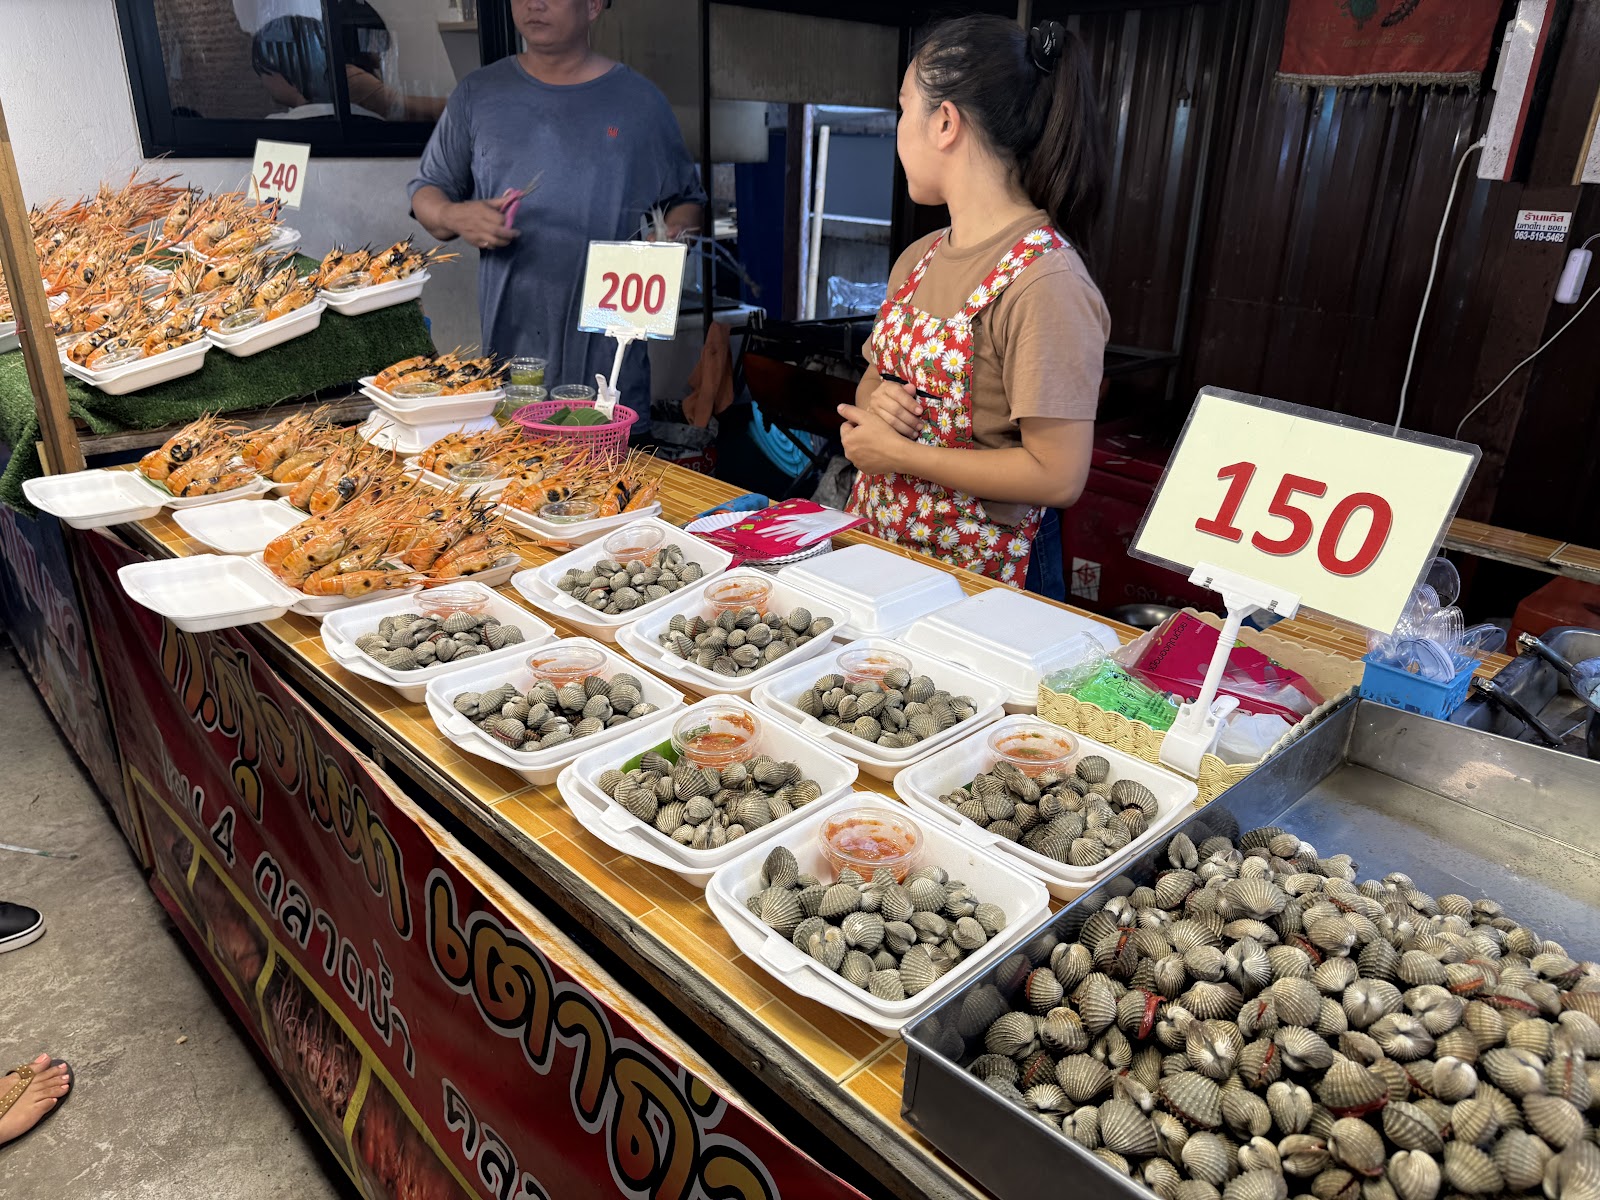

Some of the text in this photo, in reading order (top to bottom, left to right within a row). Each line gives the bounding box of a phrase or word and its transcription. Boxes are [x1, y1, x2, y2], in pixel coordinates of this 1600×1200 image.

[259, 161, 298, 193] 240
[1523, 212, 1565, 222] ร้านแก๊ส
[1514, 230, 1564, 242] 063-519-5462
[599, 272, 666, 315] 200
[1195, 461, 1394, 577] 150
[210, 806, 236, 868] 4
[253, 850, 417, 1078] ตลาดน้ำ
[441, 1077, 552, 1200] คล
